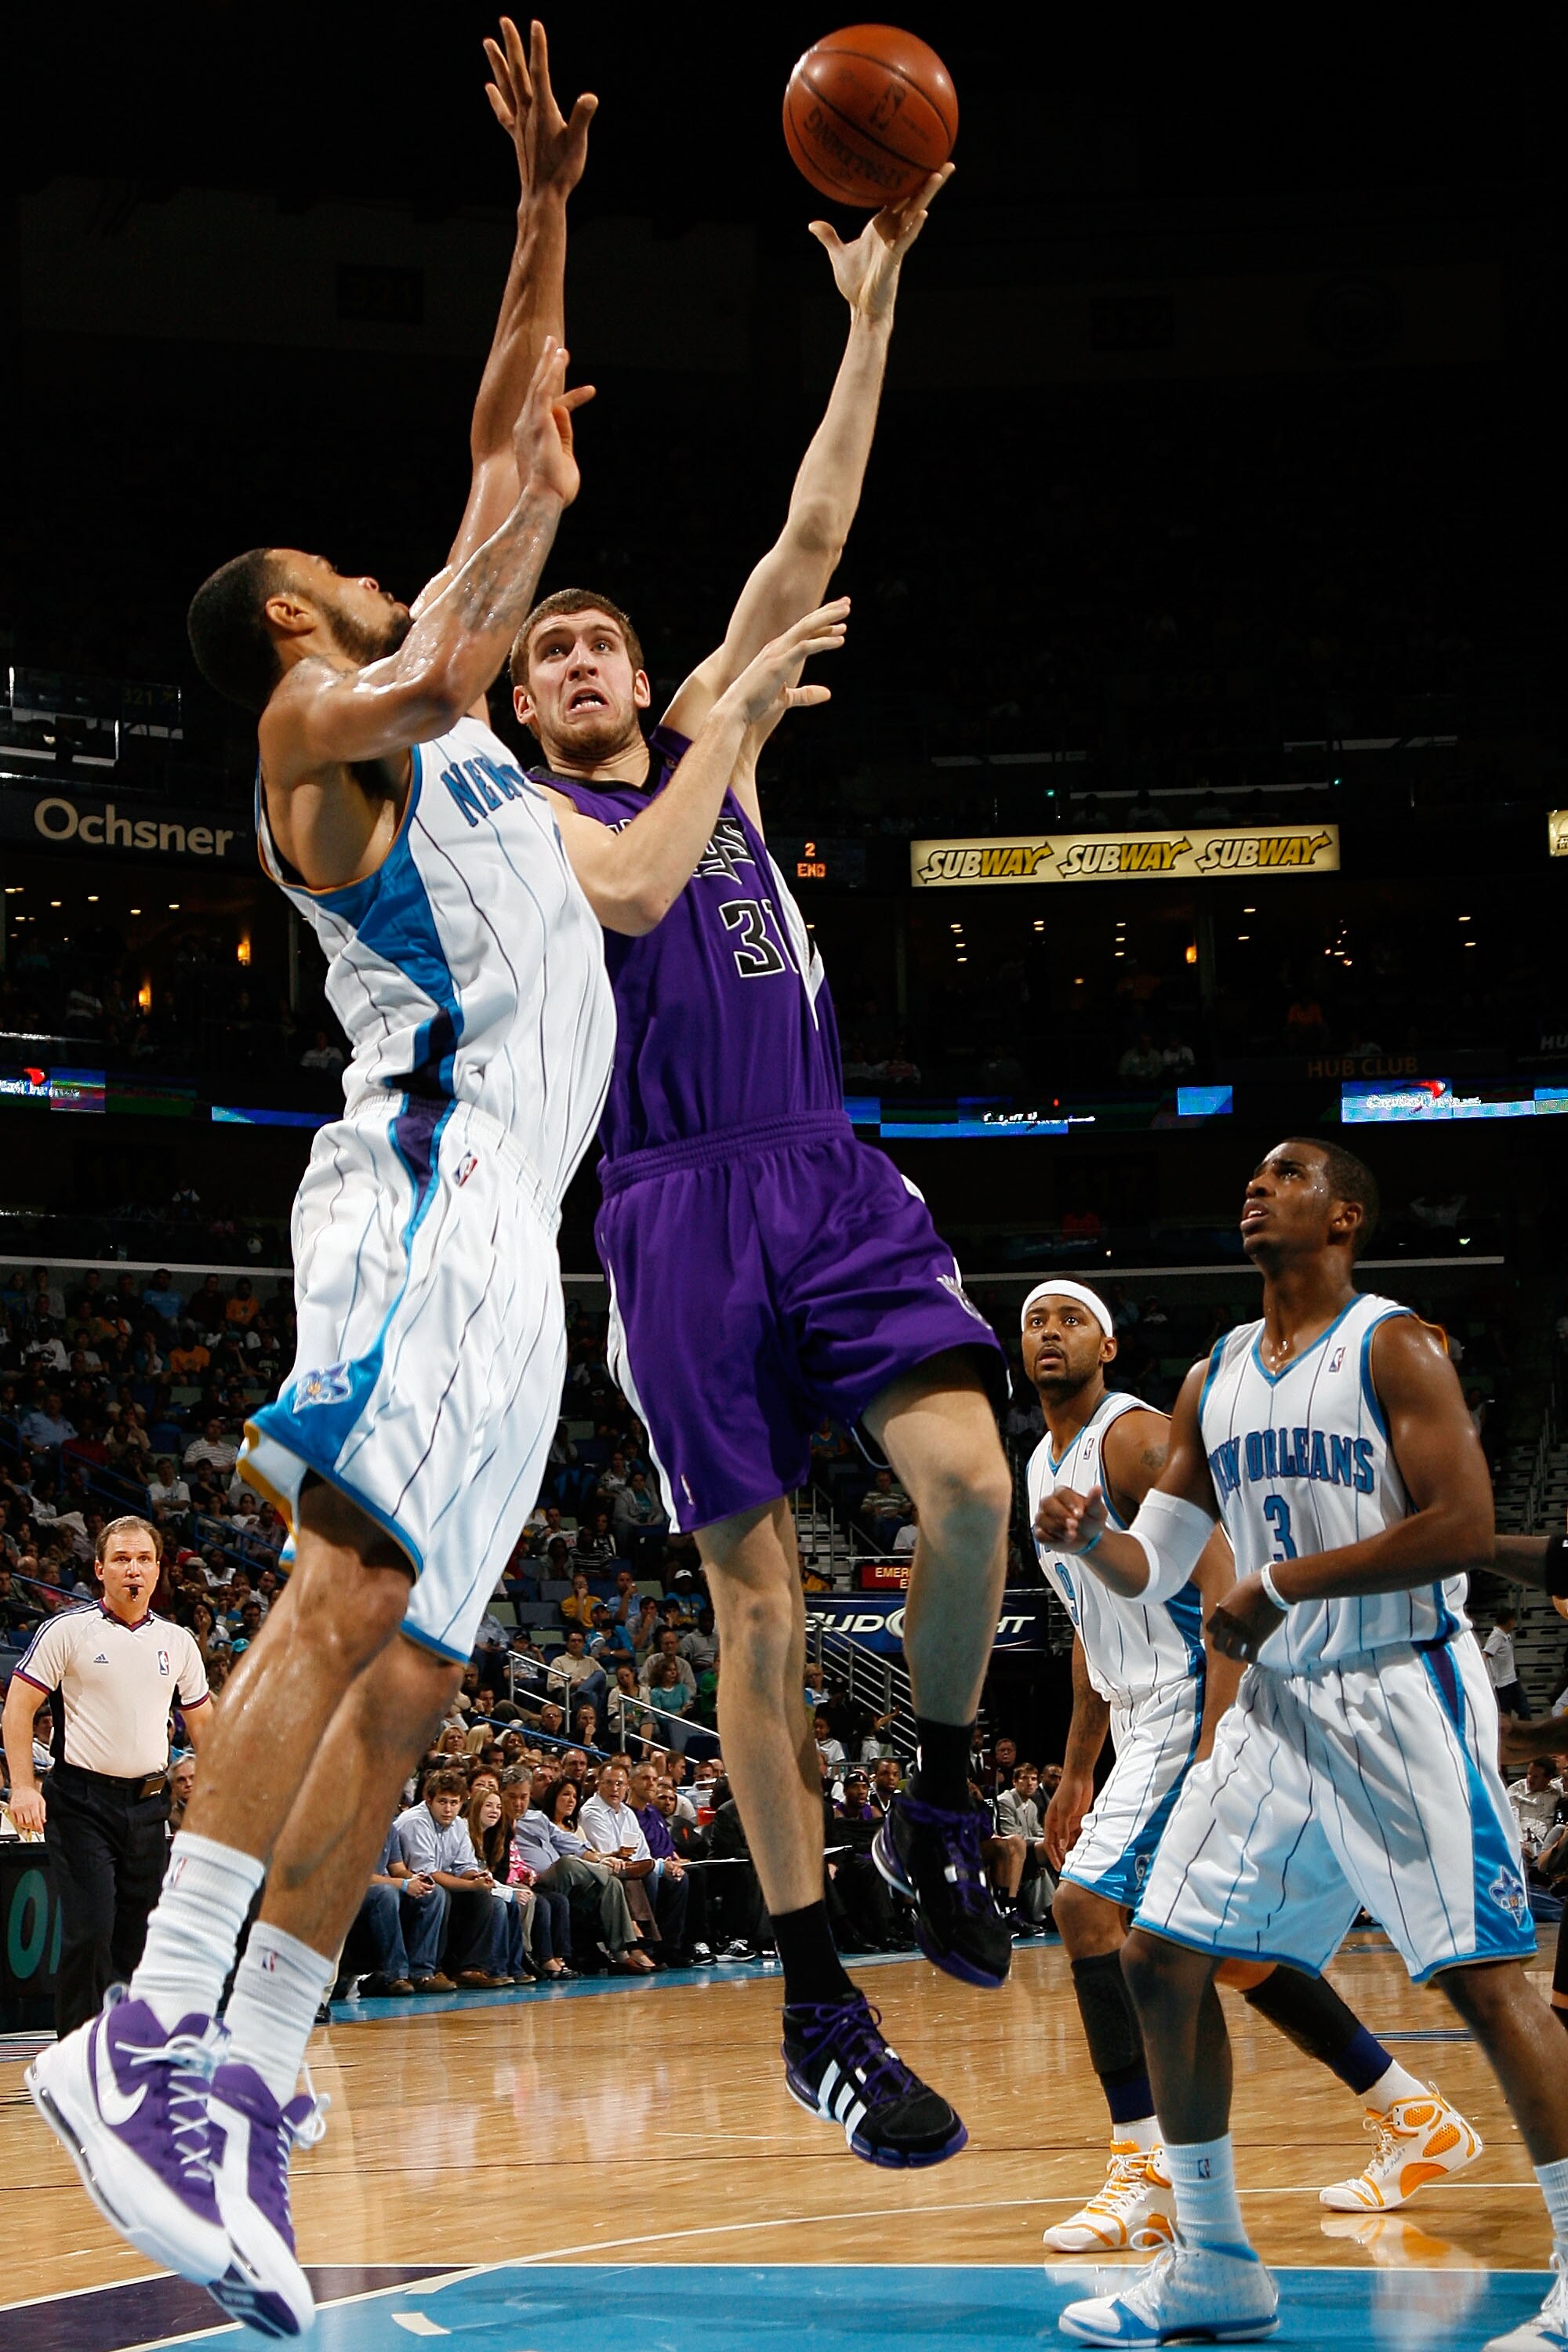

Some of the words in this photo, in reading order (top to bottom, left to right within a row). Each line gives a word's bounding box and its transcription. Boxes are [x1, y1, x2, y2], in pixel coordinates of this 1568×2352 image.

[33, 796, 234, 857] Ochsner
[804, 842, 816, 857] 2
[797, 862, 826, 877] END
[917, 841, 1054, 884] SUBWAY
[1056, 836, 1192, 879] SUBWAY
[1194, 830, 1332, 873] SUBWAY
[1305, 1058, 1356, 1080] HUB
[1360, 1055, 1418, 1076] CLUB
[1245, 1427, 1375, 1494] ORLEANS
[1263, 1494, 1298, 1562] 3
[875, 1567, 910, 1577] EMER
[1054, 1562, 1080, 1626] 9
